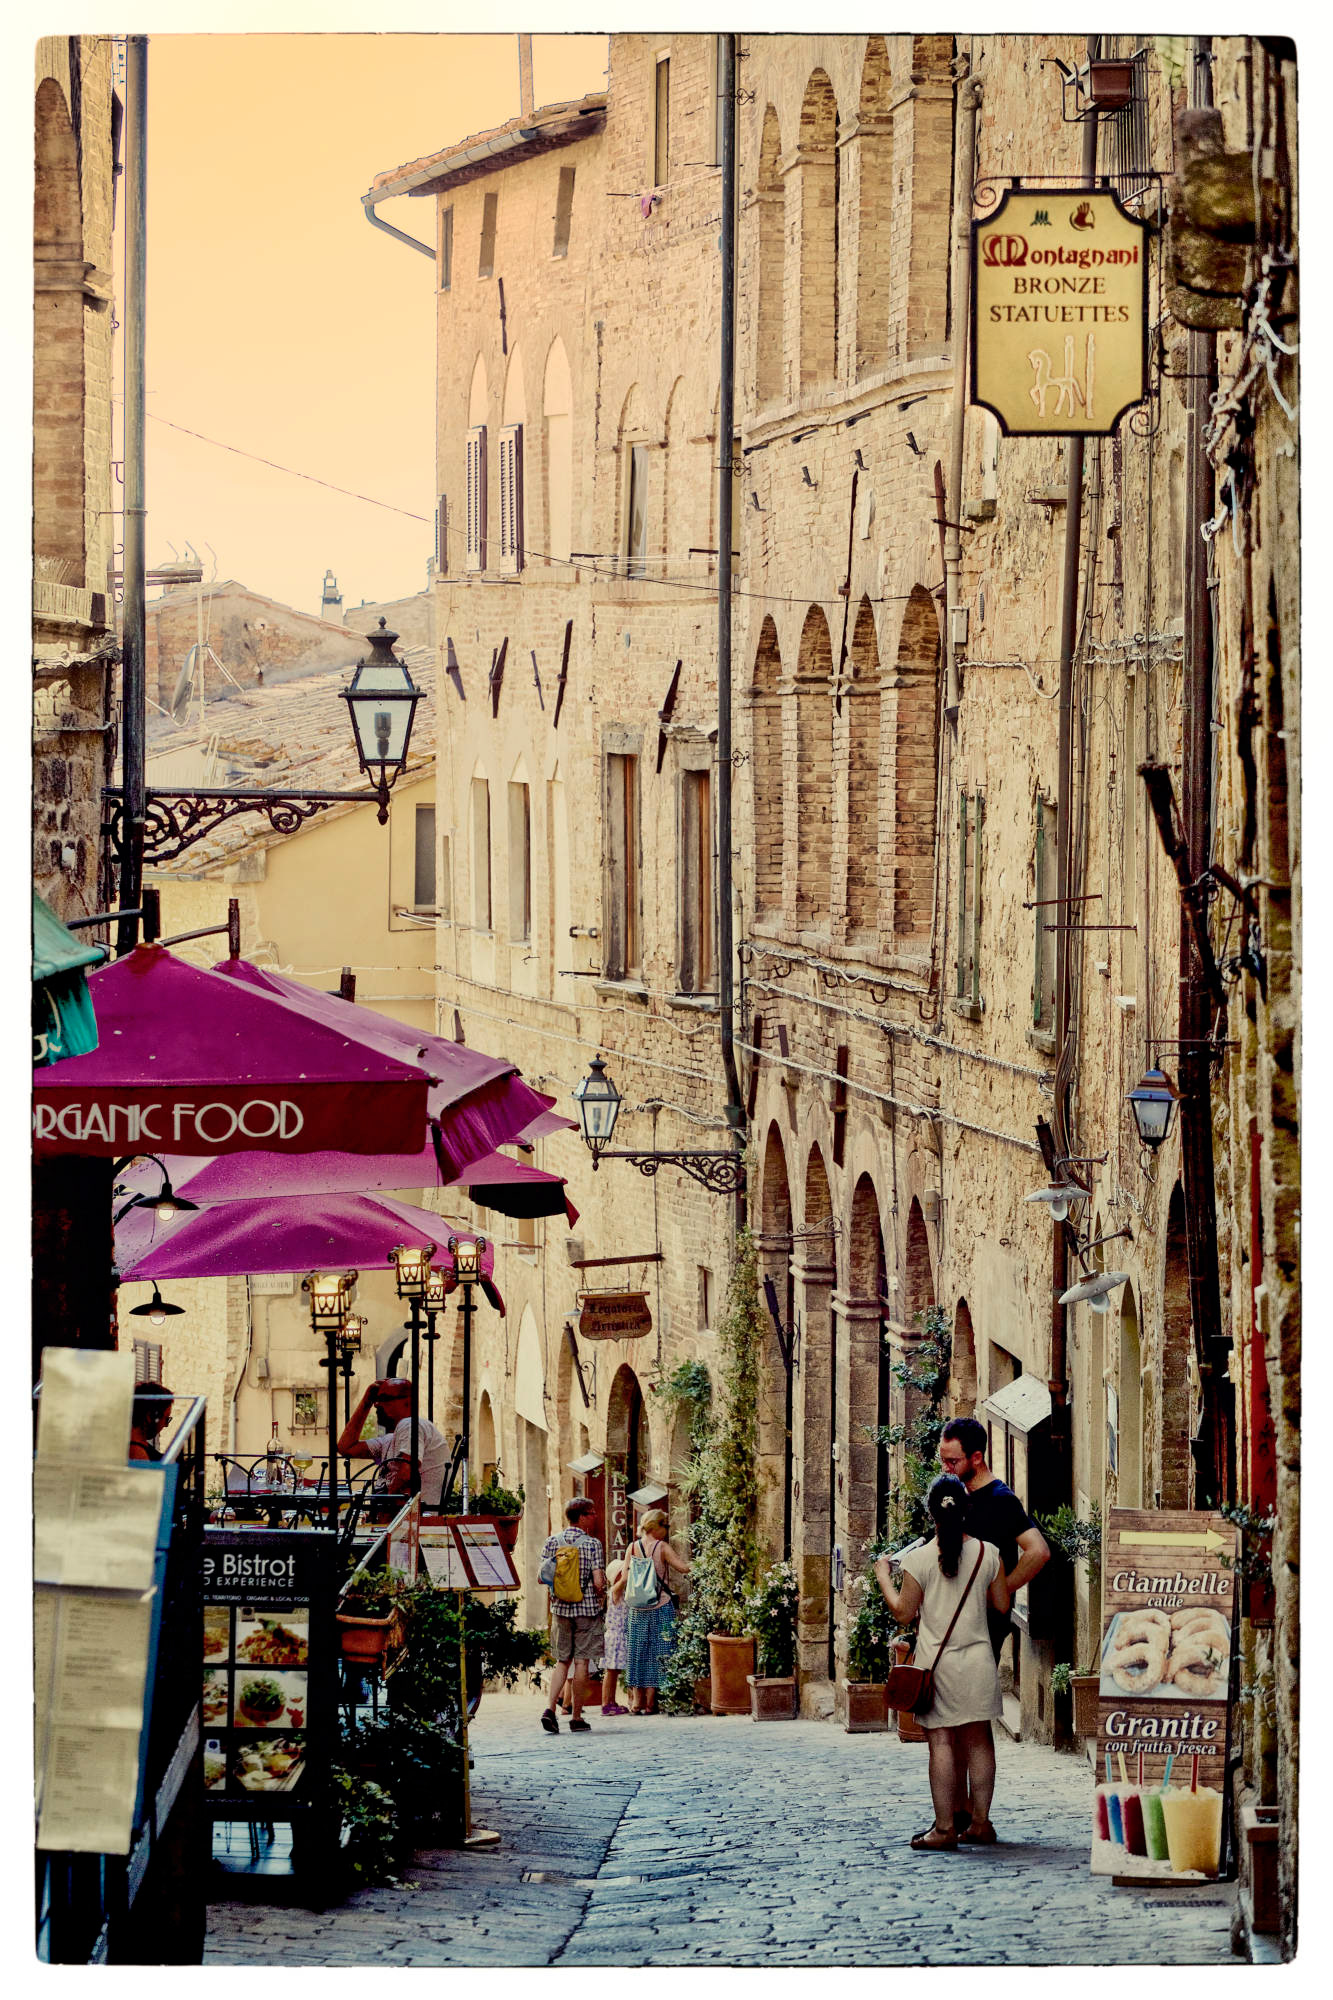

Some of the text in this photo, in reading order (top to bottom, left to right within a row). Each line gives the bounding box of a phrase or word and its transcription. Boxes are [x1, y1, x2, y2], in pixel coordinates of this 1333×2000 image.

[982, 234, 1138, 269] Montagnani
[1014, 277, 1106, 294] BRONZE
[990, 305, 1129, 322] STATUETTES
[32, 1100, 304, 1142] RGANIC FOOD
[223, 1554, 296, 1577] Bistrot
[217, 1577, 295, 1588] EXPERIENCE
[1112, 1571, 1230, 1595] Ciambelle
[1147, 1595, 1184, 1608] calde
[1105, 1711, 1218, 1739] Granite
[1105, 1739, 1217, 1758] con frutta fresca
